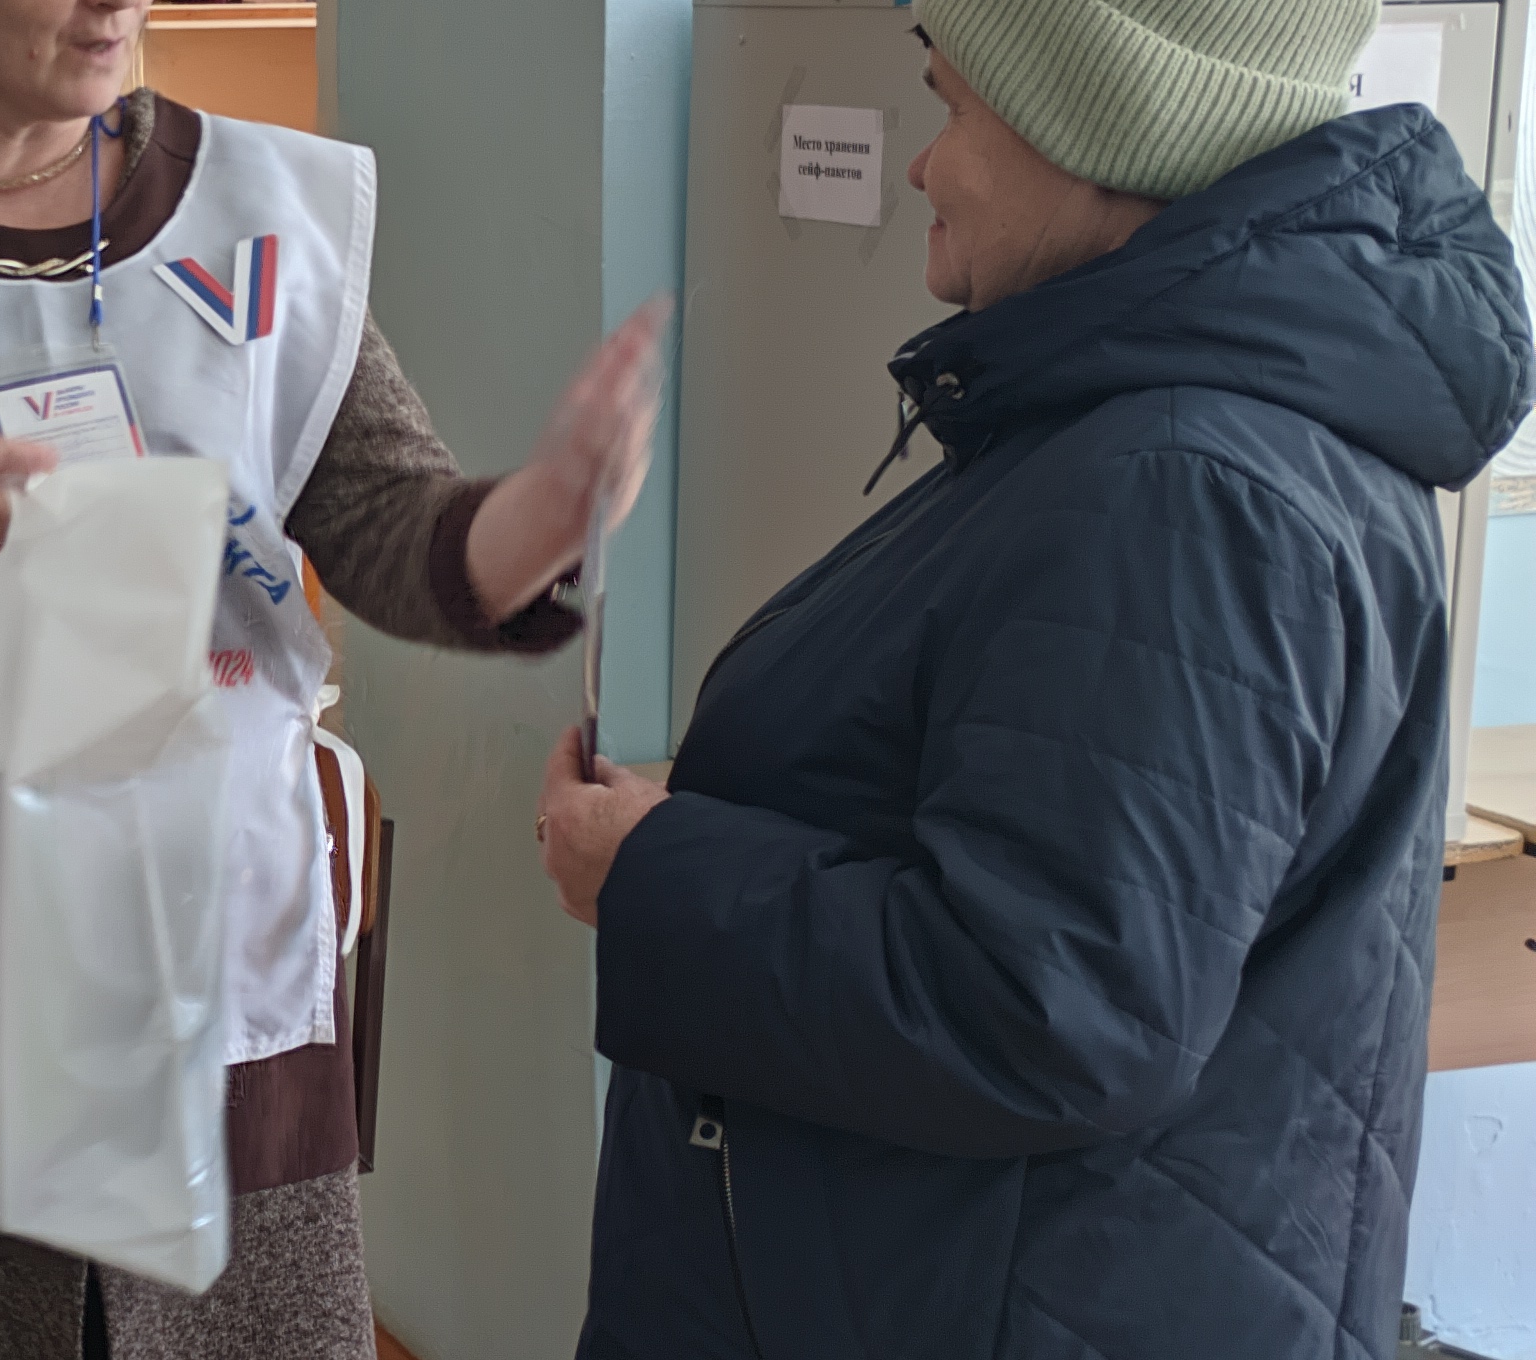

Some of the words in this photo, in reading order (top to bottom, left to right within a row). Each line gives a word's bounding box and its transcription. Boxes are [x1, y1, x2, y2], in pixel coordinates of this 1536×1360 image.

[793, 134, 822, 152] Место
[798, 161, 862, 181] сейф-пакетов
[208, 648, 255, 688] 024
